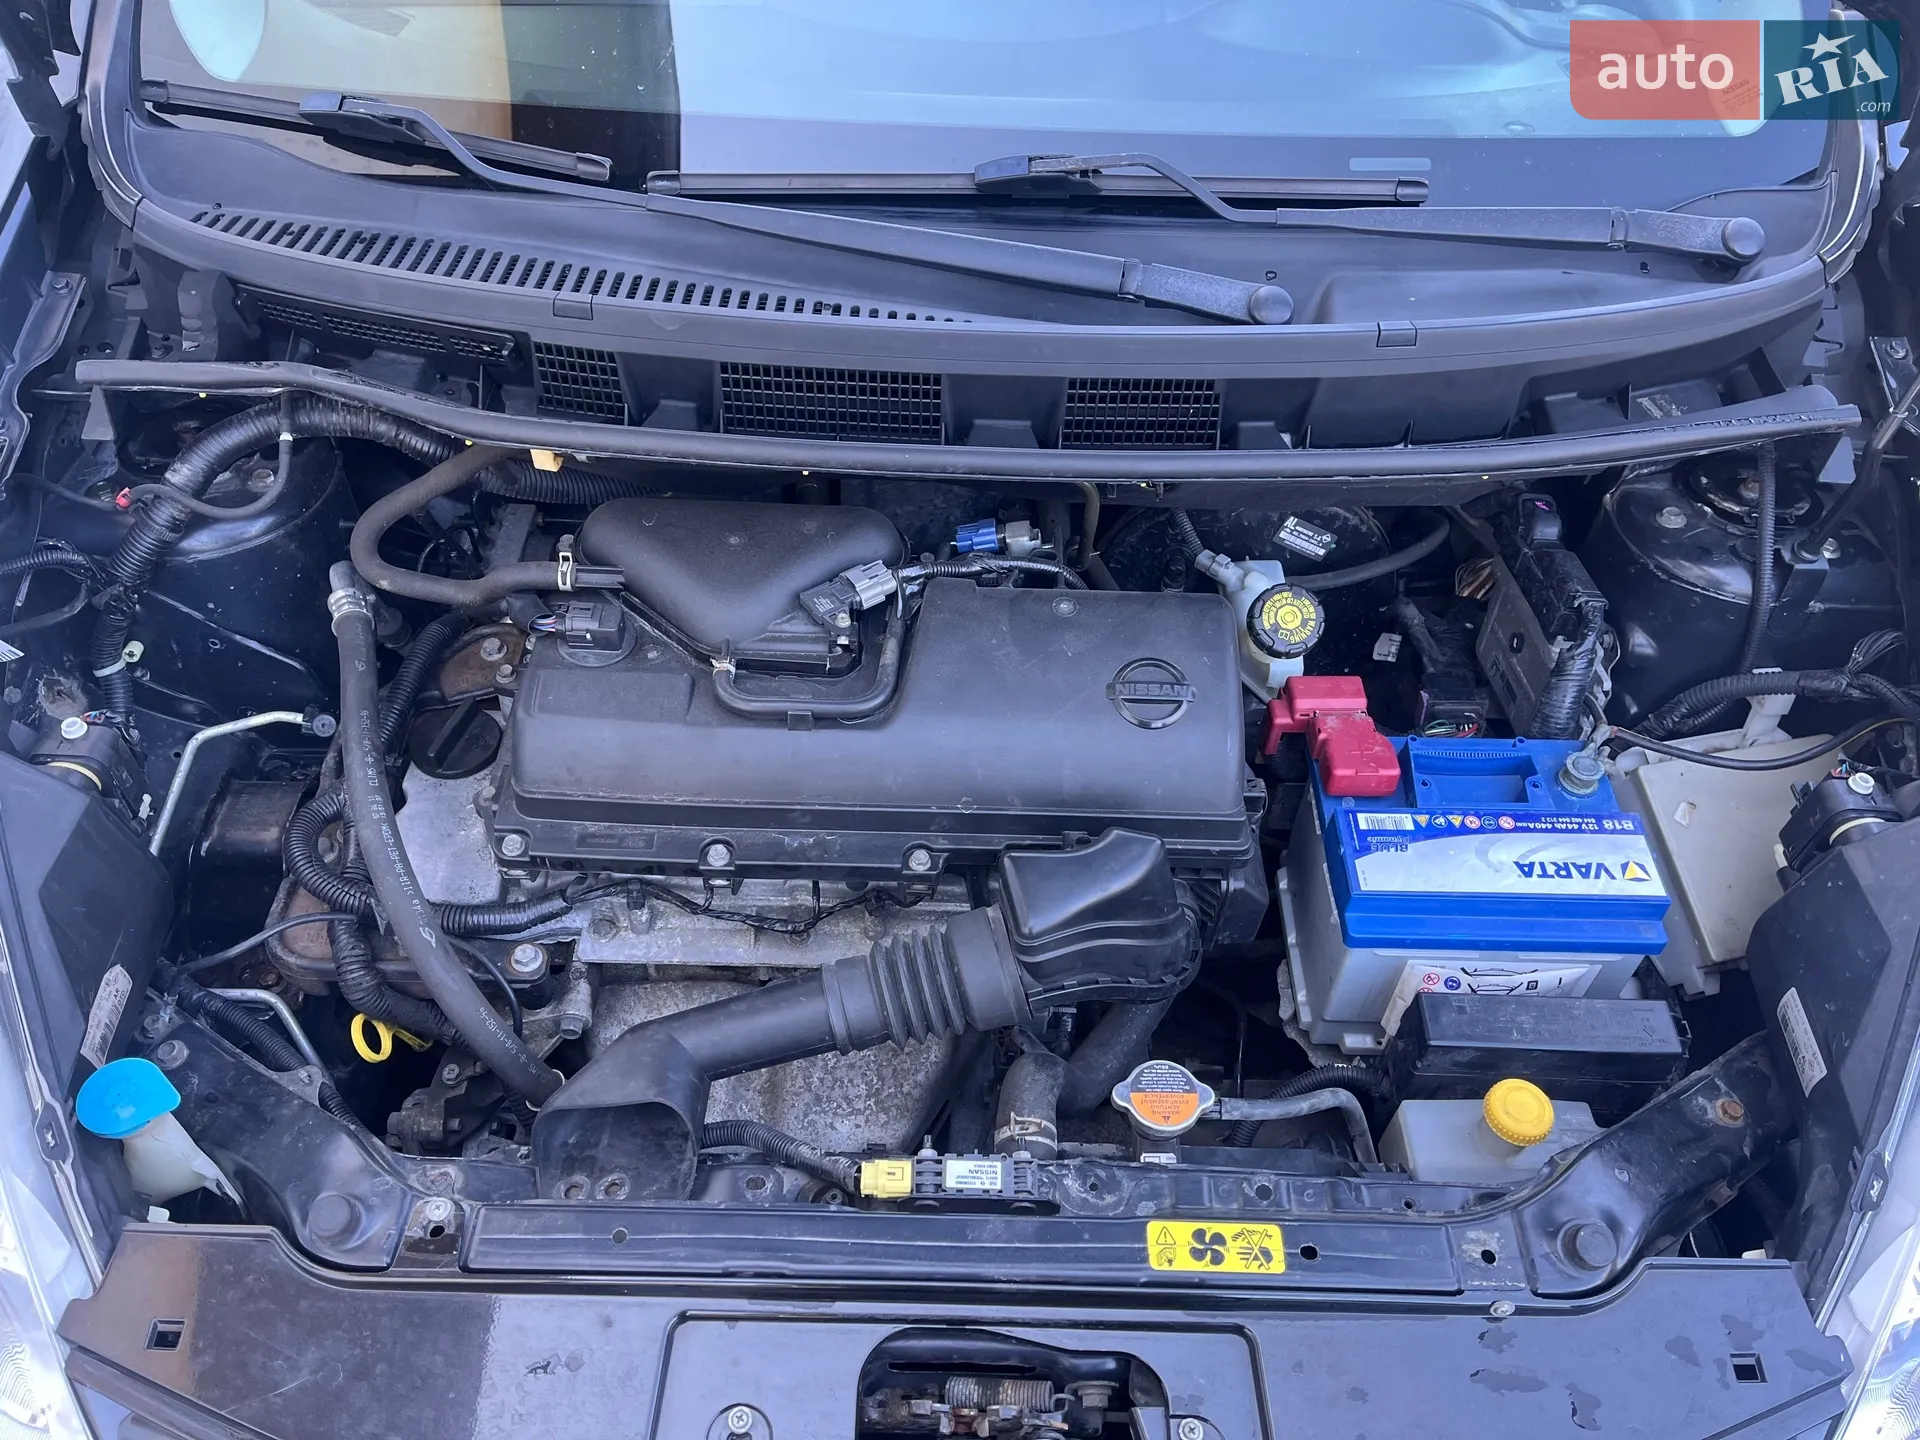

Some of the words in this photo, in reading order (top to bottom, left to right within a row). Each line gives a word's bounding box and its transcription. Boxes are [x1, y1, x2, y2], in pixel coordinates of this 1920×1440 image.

[1290, 620, 1316, 644] WARNING
[1115, 683, 1188, 697] NISSAN
[1581, 822, 1599, 830] 12V
[1602, 819, 1635, 831] B18
[1367, 836, 1410, 844] Dynamic
[1371, 843, 1409, 853] BLUE
[1512, 861, 1617, 880] VARTA
